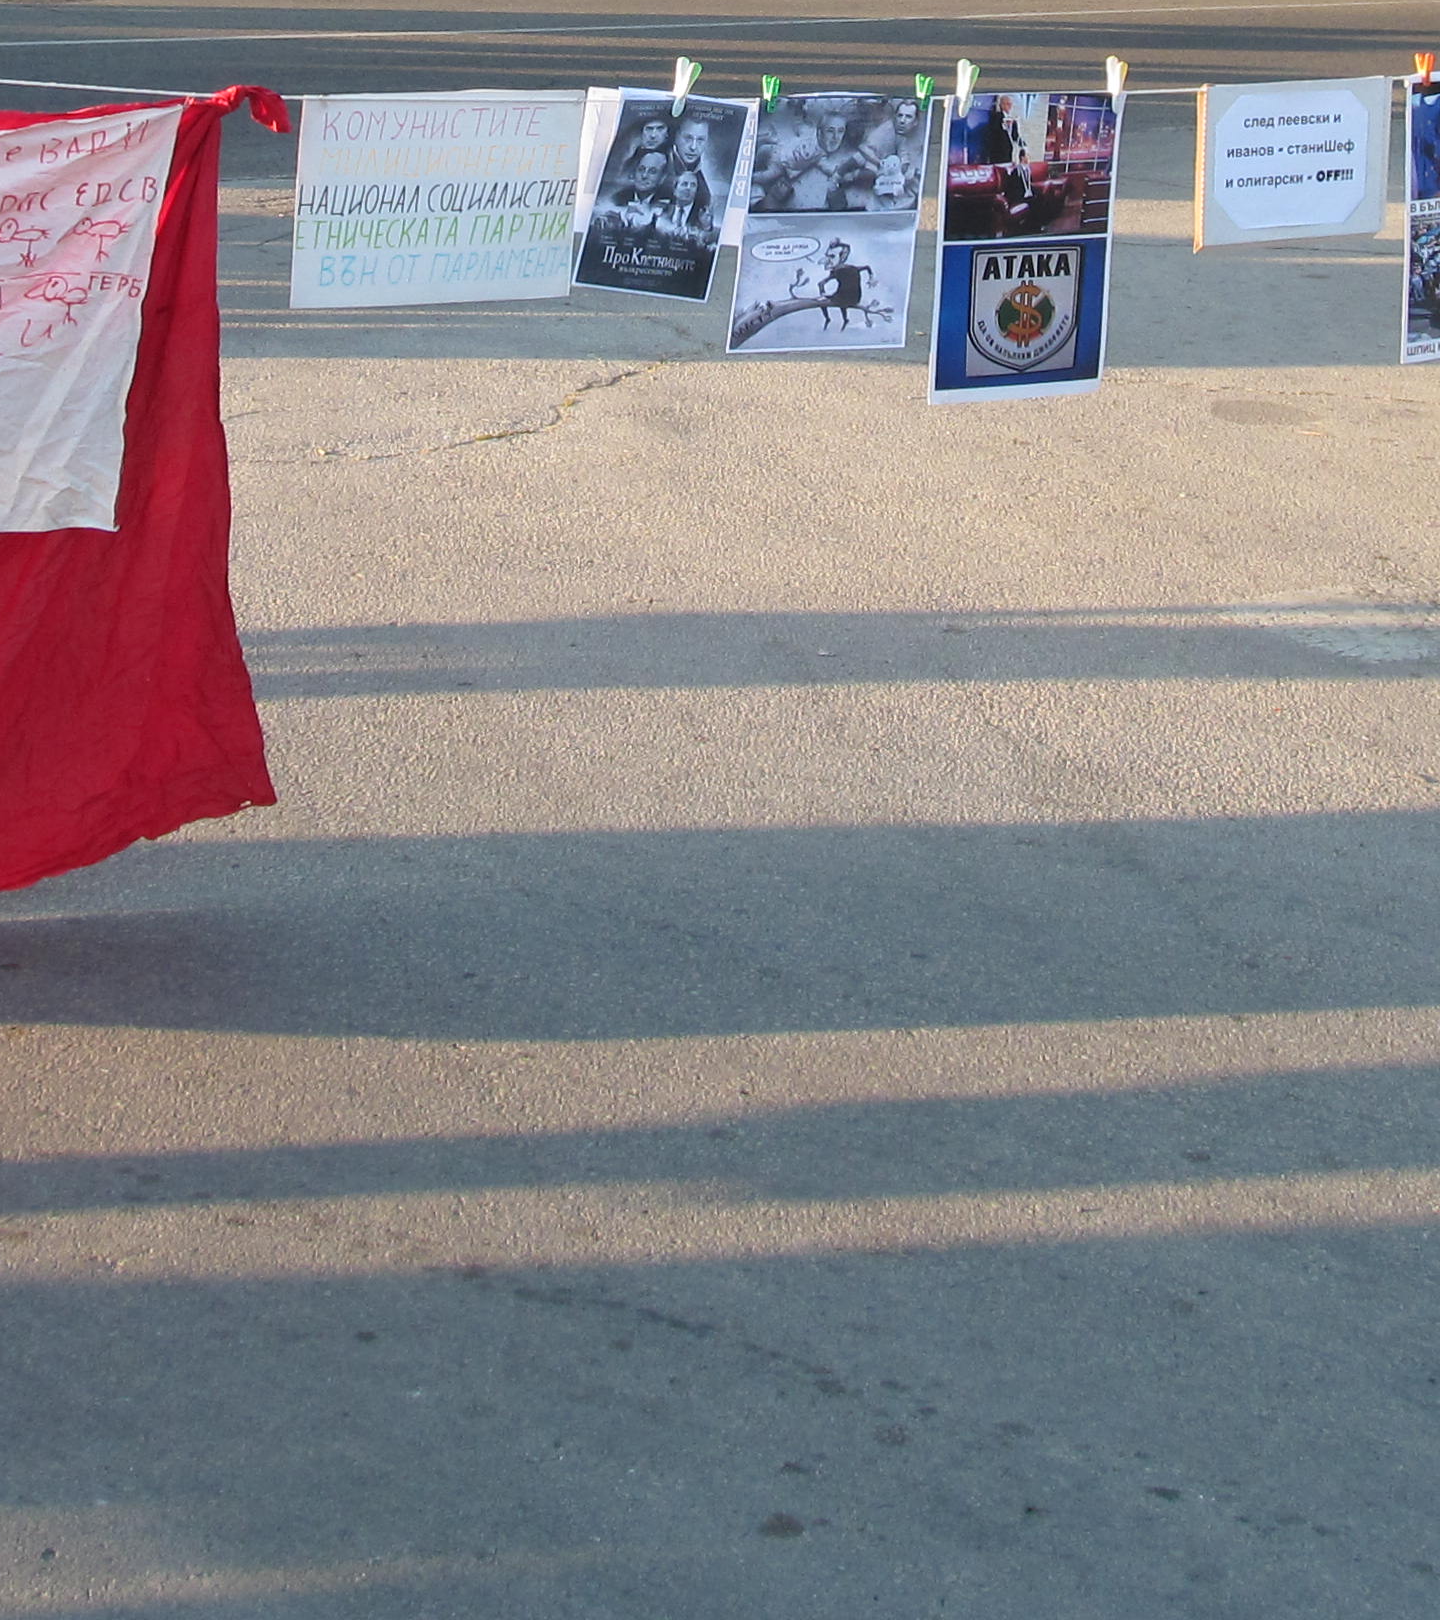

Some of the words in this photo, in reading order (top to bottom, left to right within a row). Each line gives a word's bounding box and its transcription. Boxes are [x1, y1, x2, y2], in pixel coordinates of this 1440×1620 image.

[323, 107, 548, 141] КОМУНИСТИТЕ
[1244, 116, 1275, 130] след
[1278, 114, 1330, 127] пеевски
[1333, 113, 1342, 123] и
[320, 144, 571, 179] МИЛИЦИОНЕРИТЕ
[1227, 146, 1275, 158] иванов
[1287, 139, 1355, 154] станиШеф
[1225, 178, 1233, 188] и
[1237, 174, 1303, 188] олигарски
[1316, 168, 1354, 182] OFF!!!
[297, 183, 420, 217] НАЦИОНАЛ
[427, 180, 578, 214] СОЦИАЛИСТИТЕ
[1410, 203, 1417, 213] В
[295, 216, 459, 250] ЕТНИЧЕСКАТА
[468, 212, 572, 246] ПАРТИЯ
[319, 255, 378, 287] ВЪН
[387, 253, 422, 284] ОТ
[428, 245, 571, 282] ПАРЛАМЕНТА
[982, 253, 1071, 281] АТАКА
[88, 275, 141, 298] ГЕРБ
